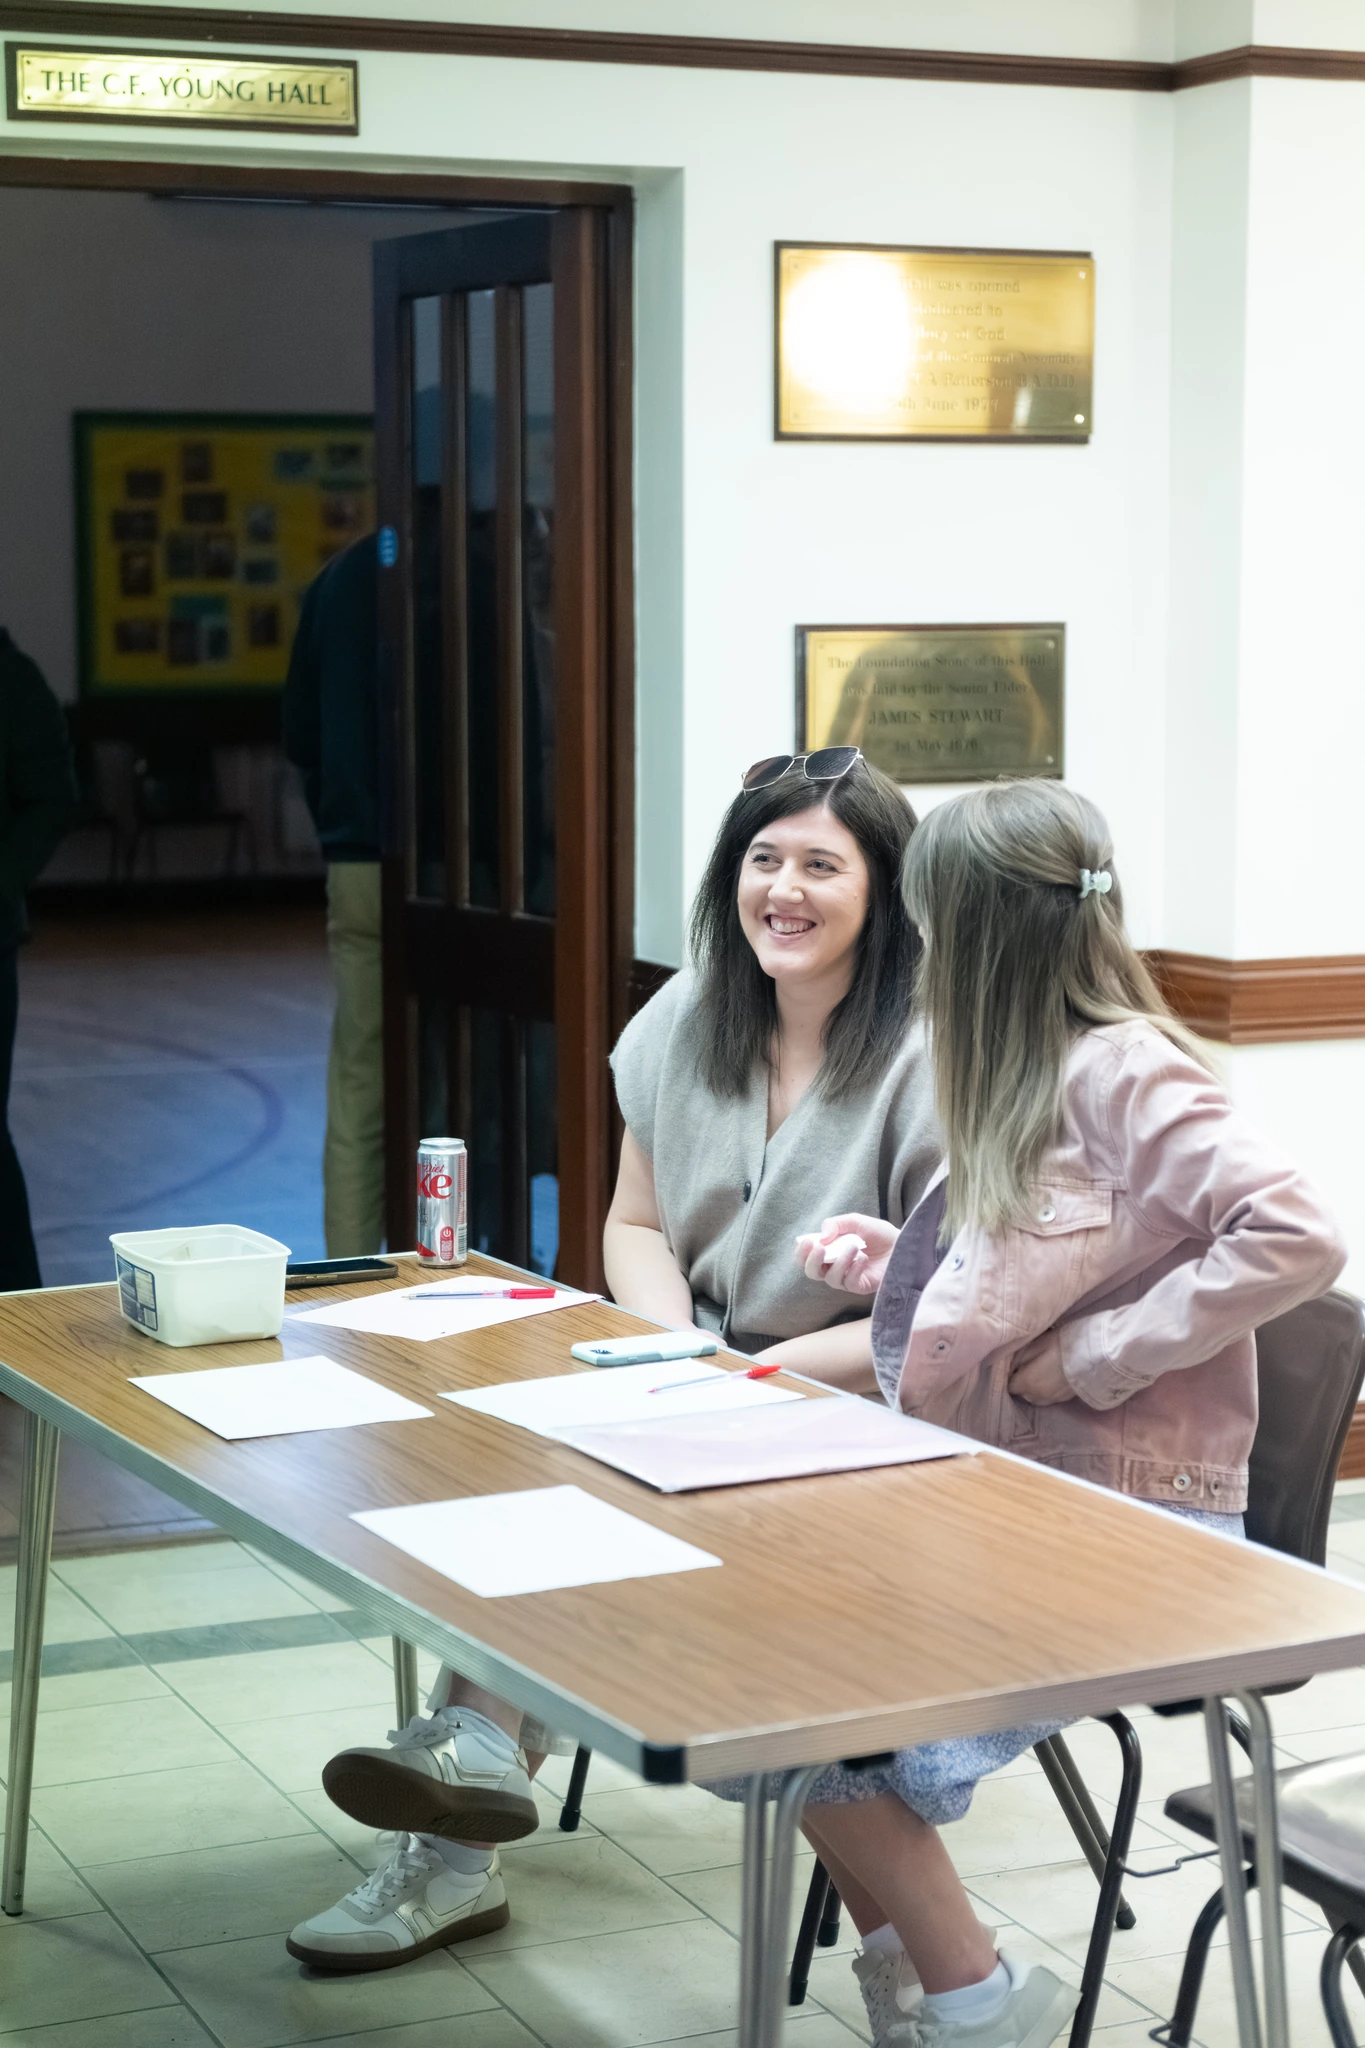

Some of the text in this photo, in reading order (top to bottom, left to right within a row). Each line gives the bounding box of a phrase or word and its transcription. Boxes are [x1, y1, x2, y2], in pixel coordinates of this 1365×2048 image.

[41, 69, 332, 107] THE C.F. YOUNG HALL
[936, 279, 964, 293] was
[968, 278, 1021, 297] opened
[988, 303, 1004, 318] to
[954, 327, 970, 341] of
[976, 326, 1007, 342] God
[937, 350, 959, 364] the
[963, 350, 1014, 365] General
[945, 372, 1013, 388] Patterson
[922, 395, 959, 412] June
[828, 651, 1047, 669] The Foundation Stone of this Hall
[846, 685, 868, 697] was
[872, 681, 896, 697] laid
[902, 682, 918, 699] by
[923, 681, 942, 696] the
[868, 707, 1007, 727] JAMES STEWART
[421, 1162, 445, 1174] Diet
